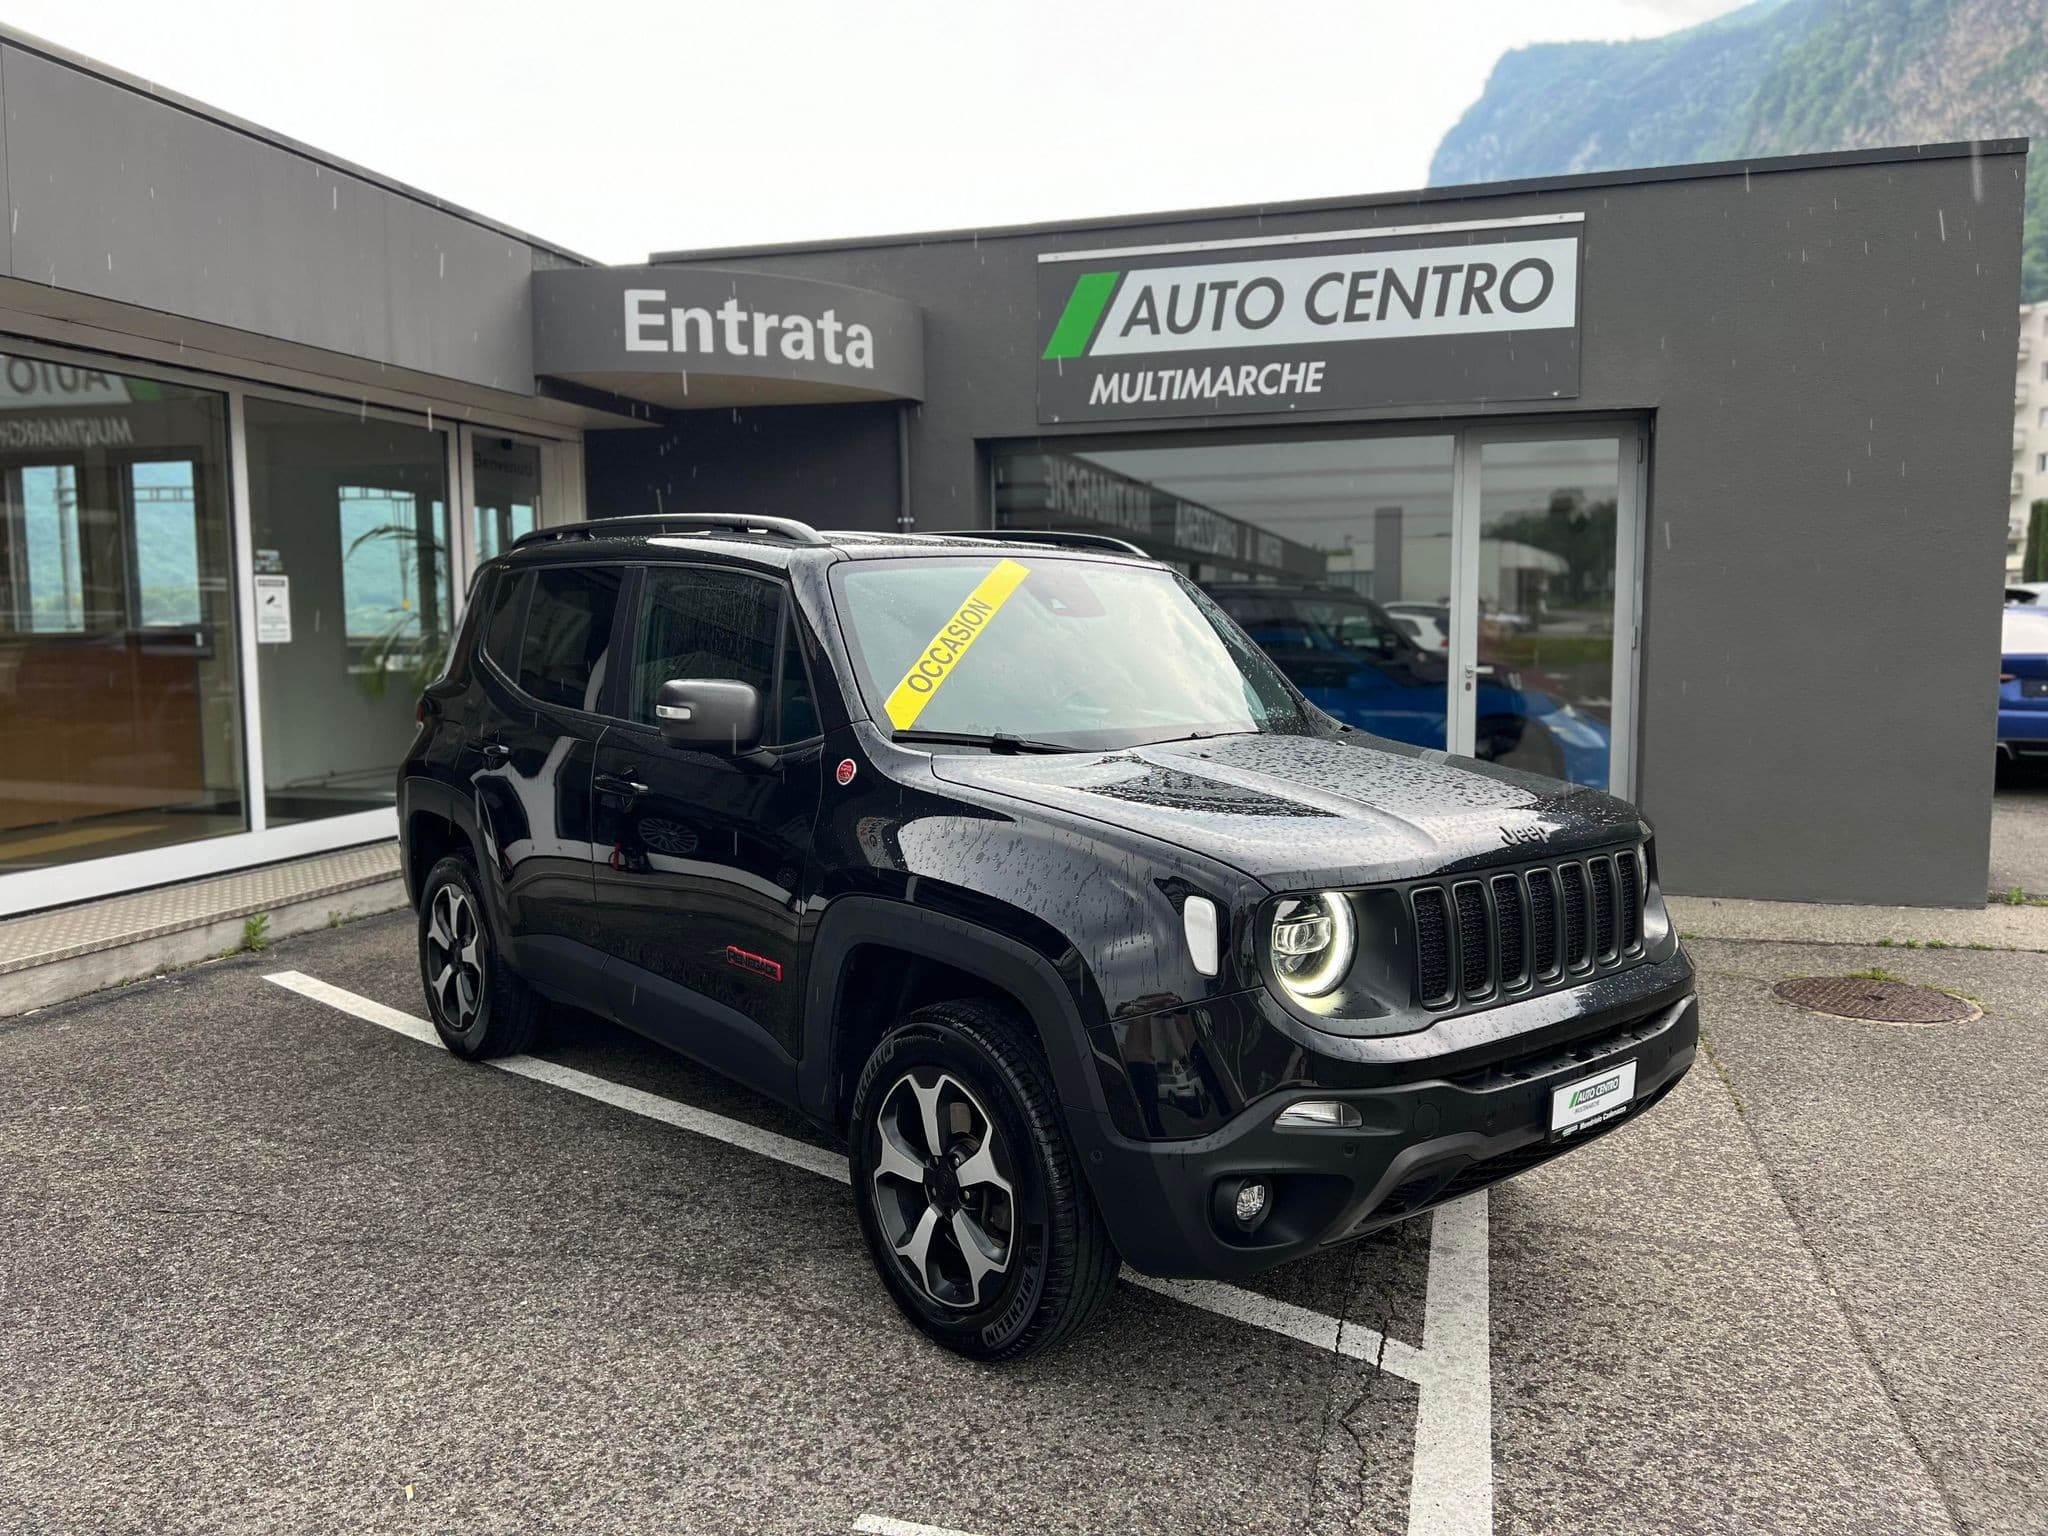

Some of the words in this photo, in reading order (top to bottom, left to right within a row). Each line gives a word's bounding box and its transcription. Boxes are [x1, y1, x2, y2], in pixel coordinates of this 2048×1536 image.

[624, 288, 875, 369] Entrata
[1119, 276, 1285, 338] AUTO
[1304, 257, 1555, 326] CENTRO
[1088, 360, 1326, 406] MULTIMARCHE
[906, 597, 993, 693] OCCASION
[1499, 825, 1551, 846] Jeep
[1577, 1087, 1595, 1103] AUTO
[1595, 1078, 1619, 1097] CENTRO
[983, 1271, 1035, 1347] MICHELIN
